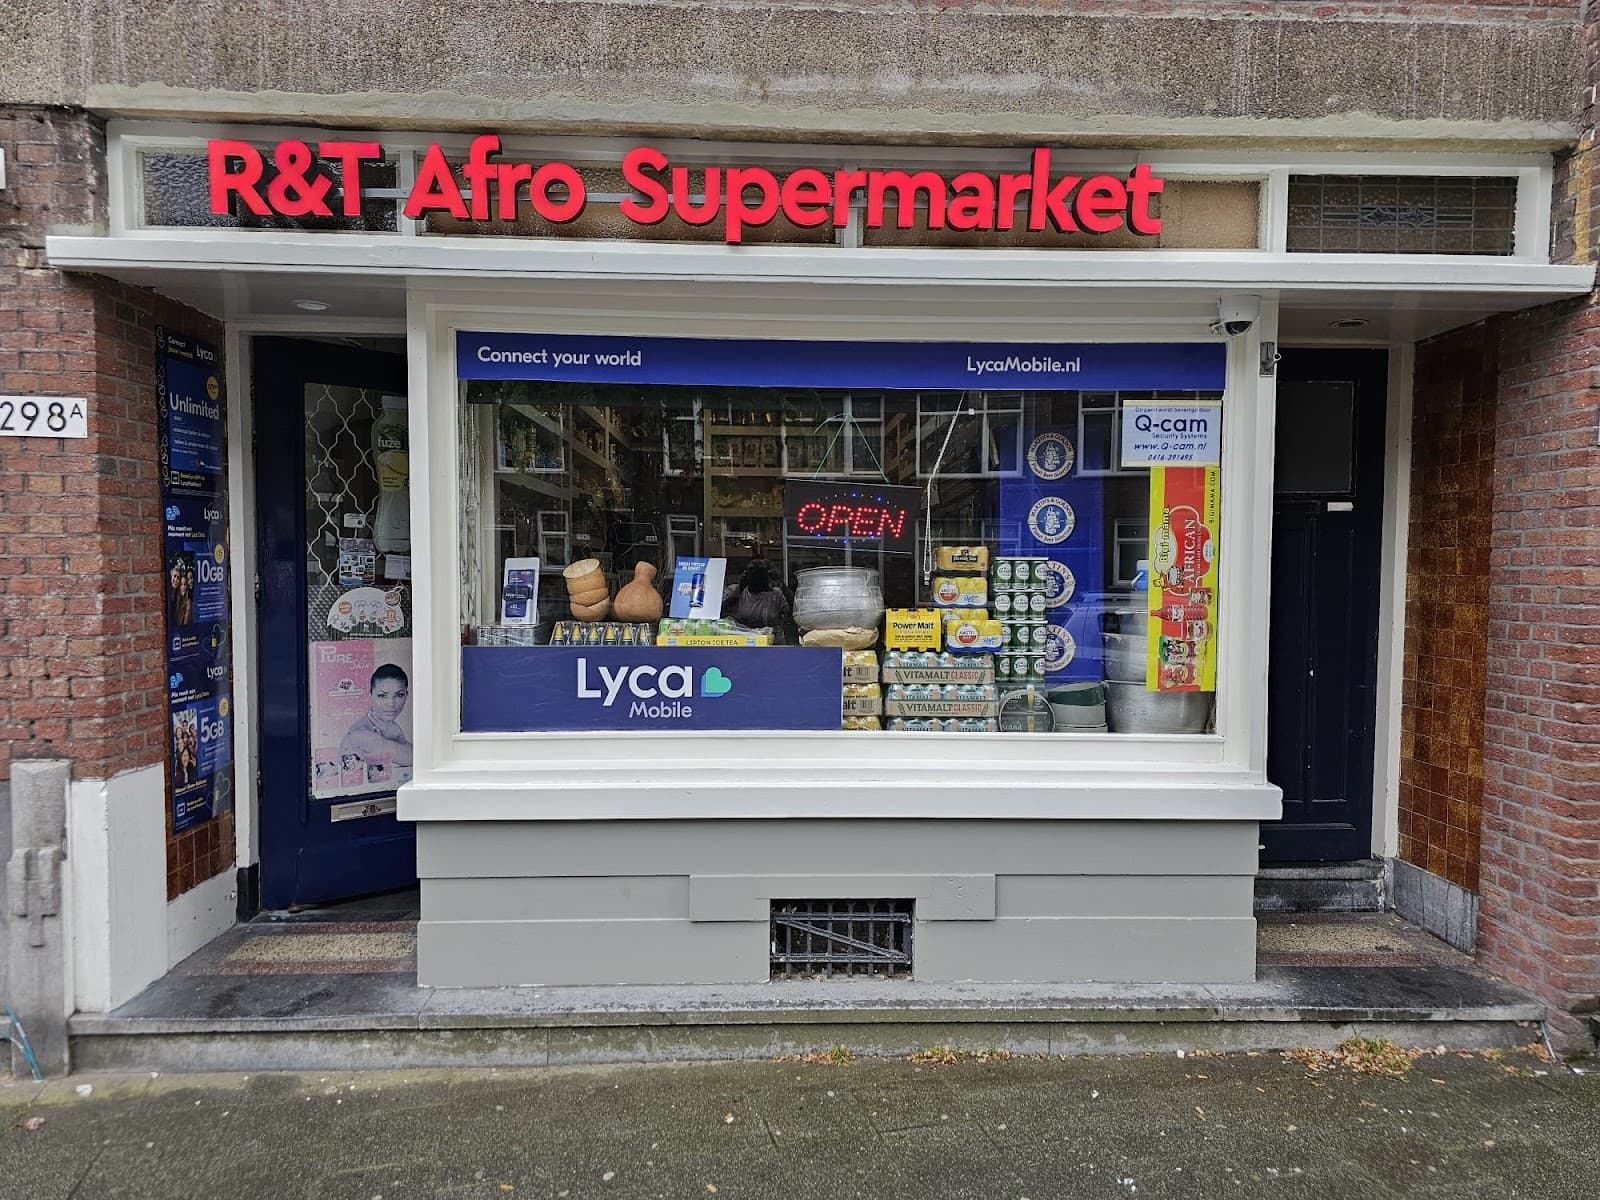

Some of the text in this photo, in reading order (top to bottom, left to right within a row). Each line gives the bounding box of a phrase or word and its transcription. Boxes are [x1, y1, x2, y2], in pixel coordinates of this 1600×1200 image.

[207, 134, 1165, 244] R&T Afro Supermarket
[196, 344, 214, 361] Lyca
[476, 345, 642, 368] Connect your world
[966, 355, 1081, 376] LycaMobile.nl
[169, 391, 220, 420] Unlimited
[1135, 414, 1208, 432] Q-cam
[377, 435, 401, 448] fuze
[1134, 442, 1207, 450] www.Q-cam.nl
[204, 506, 220, 522] Lyca
[797, 503, 905, 538] OPEN
[1183, 518, 1196, 584] AFRICAN
[197, 559, 224, 583] 10GB
[893, 621, 934, 630] Power Malt
[207, 666, 223, 680] Lyca
[904, 671, 979, 680] VITAMALT CLASSIC
[577, 657, 693, 707] Lyca
[628, 702, 693, 718] Mobile
[843, 700, 856, 709] alt
[906, 703, 982, 713] VITAMALT CLASSIC
[200, 716, 224, 744] 5GB
